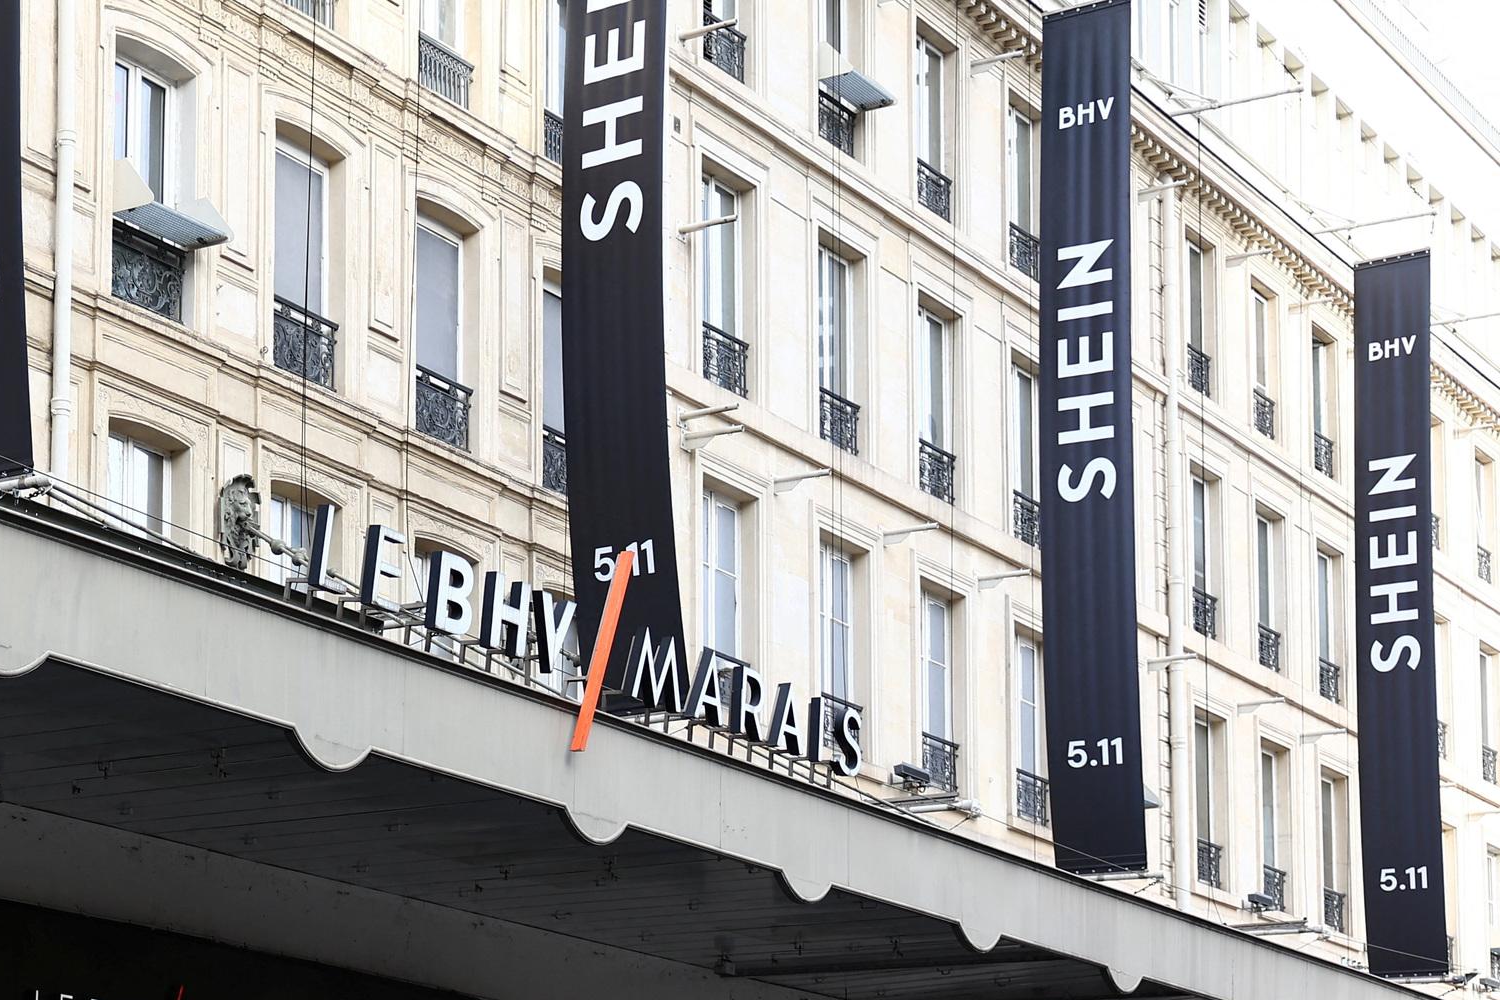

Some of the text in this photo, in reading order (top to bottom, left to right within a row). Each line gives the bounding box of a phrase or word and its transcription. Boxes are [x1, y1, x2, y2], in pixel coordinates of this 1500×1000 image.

[580, 0, 646, 242] SHE
[1058, 96, 1115, 130] BHV
[1057, 238, 1116, 503] SHEIN
[1368, 335, 1417, 362] BHV
[594, 538, 655, 582] 511
[1368, 453, 1420, 673] SHEIN
[308, 503, 862, 777] LE BHV MARAIS
[1067, 737, 1123, 768] 5.11
[1380, 866, 1428, 892] 5.11
